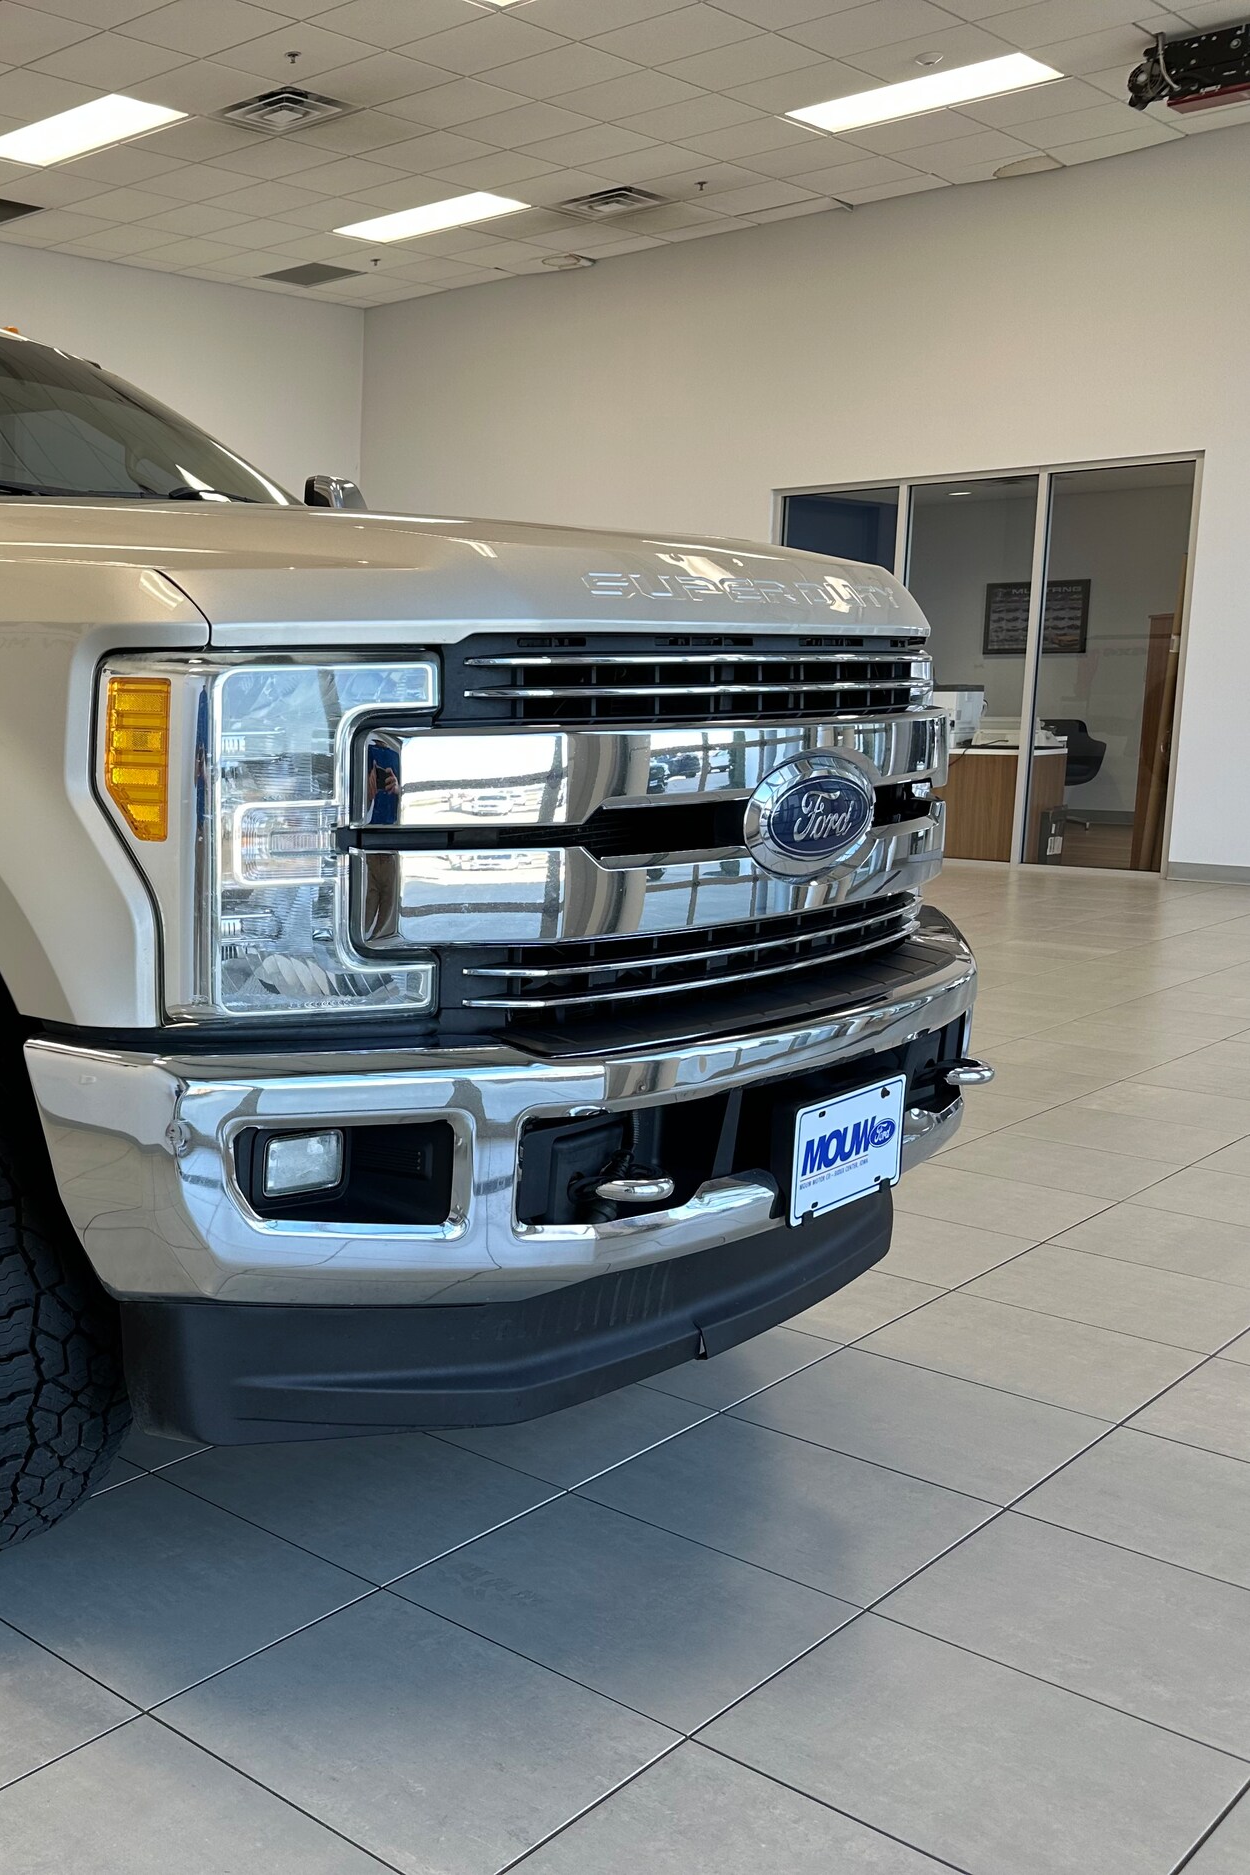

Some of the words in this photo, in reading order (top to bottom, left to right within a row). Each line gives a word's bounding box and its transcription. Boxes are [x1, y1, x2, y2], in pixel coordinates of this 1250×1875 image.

[582, 572, 795, 603] SUPER
[793, 790, 855, 842] Ford
[801, 1116, 876, 1177] MOUW
[873, 1122, 892, 1144] Ford
